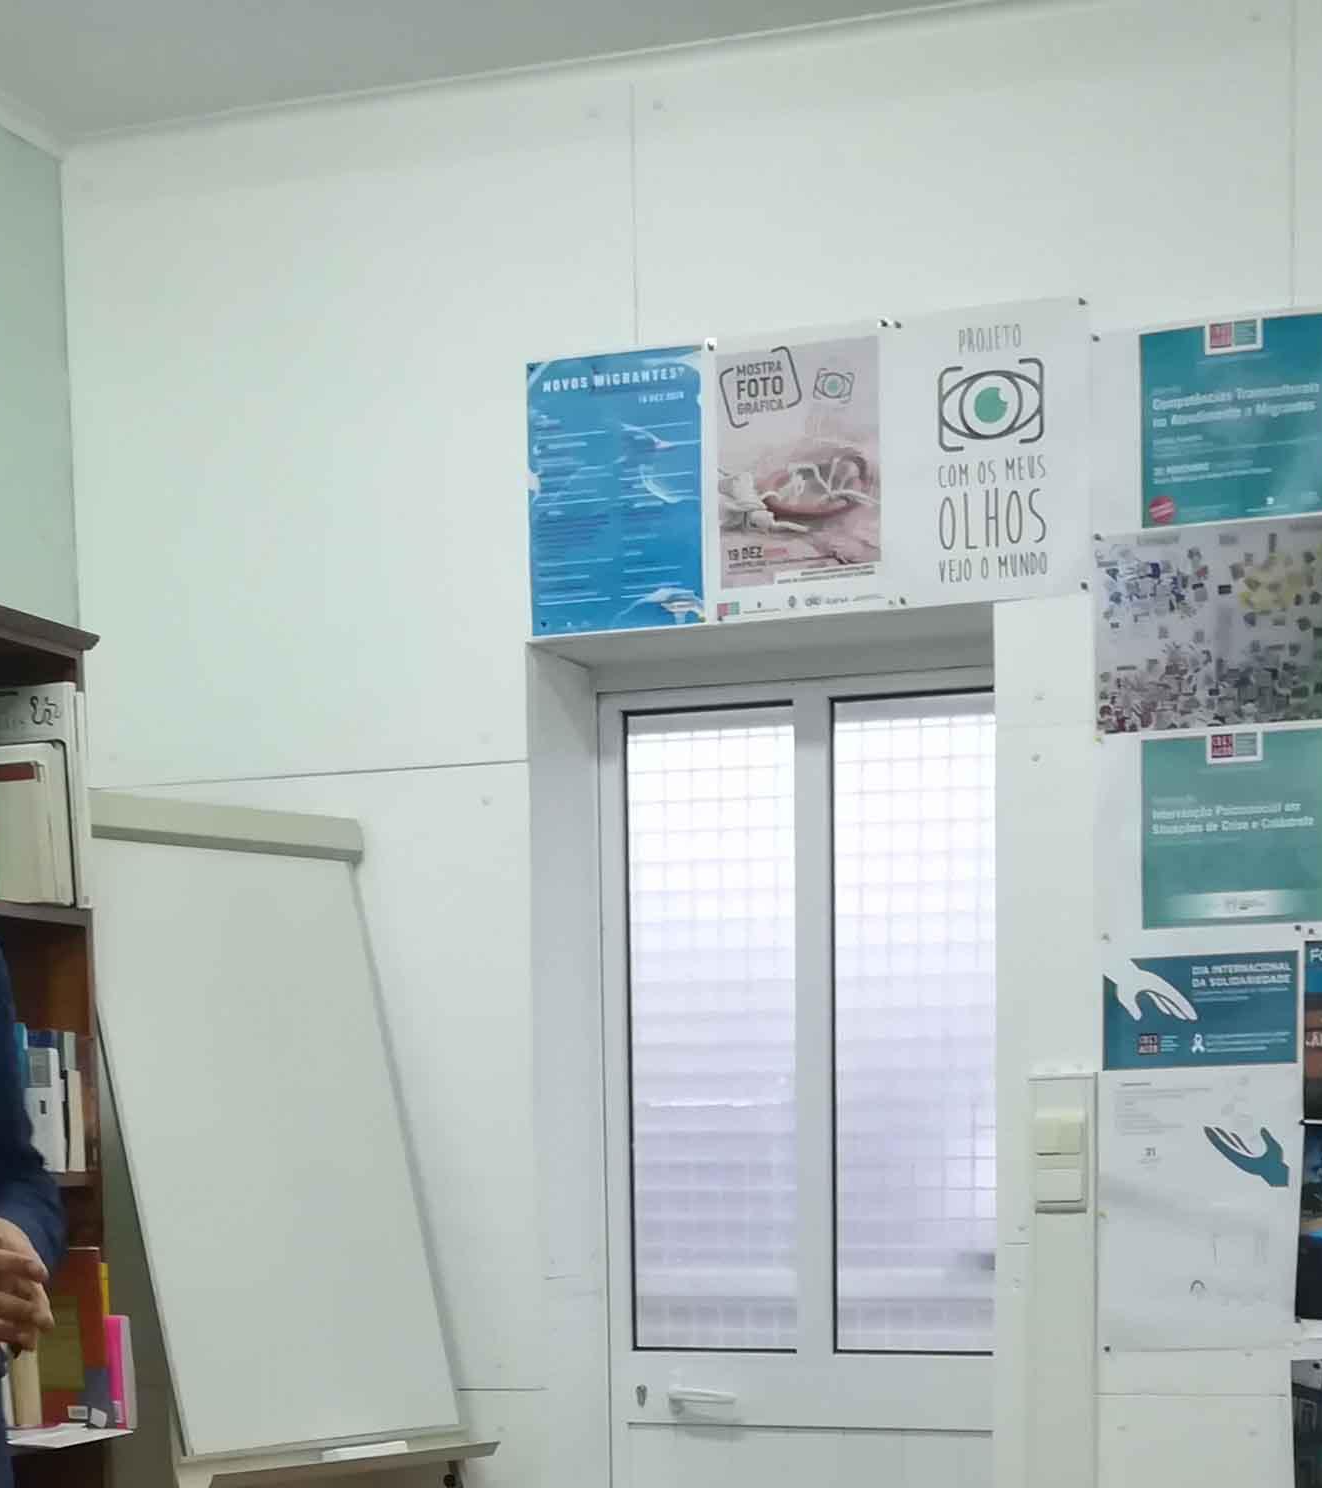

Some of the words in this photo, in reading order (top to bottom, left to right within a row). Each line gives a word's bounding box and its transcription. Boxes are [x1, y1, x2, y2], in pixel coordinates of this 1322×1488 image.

[958, 324, 1022, 353] PROJETO
[736, 360, 782, 377] MOSTRA
[542, 376, 589, 393] NOVOS
[737, 376, 784, 400] FOTO
[938, 463, 969, 489] COM
[978, 460, 997, 485] OS
[1005, 454, 1047, 482] MEUS
[939, 487, 1047, 551] OLHOS
[742, 546, 764, 560] DEZ
[939, 556, 973, 584] VEJO
[981, 555, 990, 580] O
[998, 551, 1048, 579] MUNDO
[1211, 961, 1292, 975] INTERNACIONAL
[1209, 973, 1292, 987] SOLIDARIEDADE
